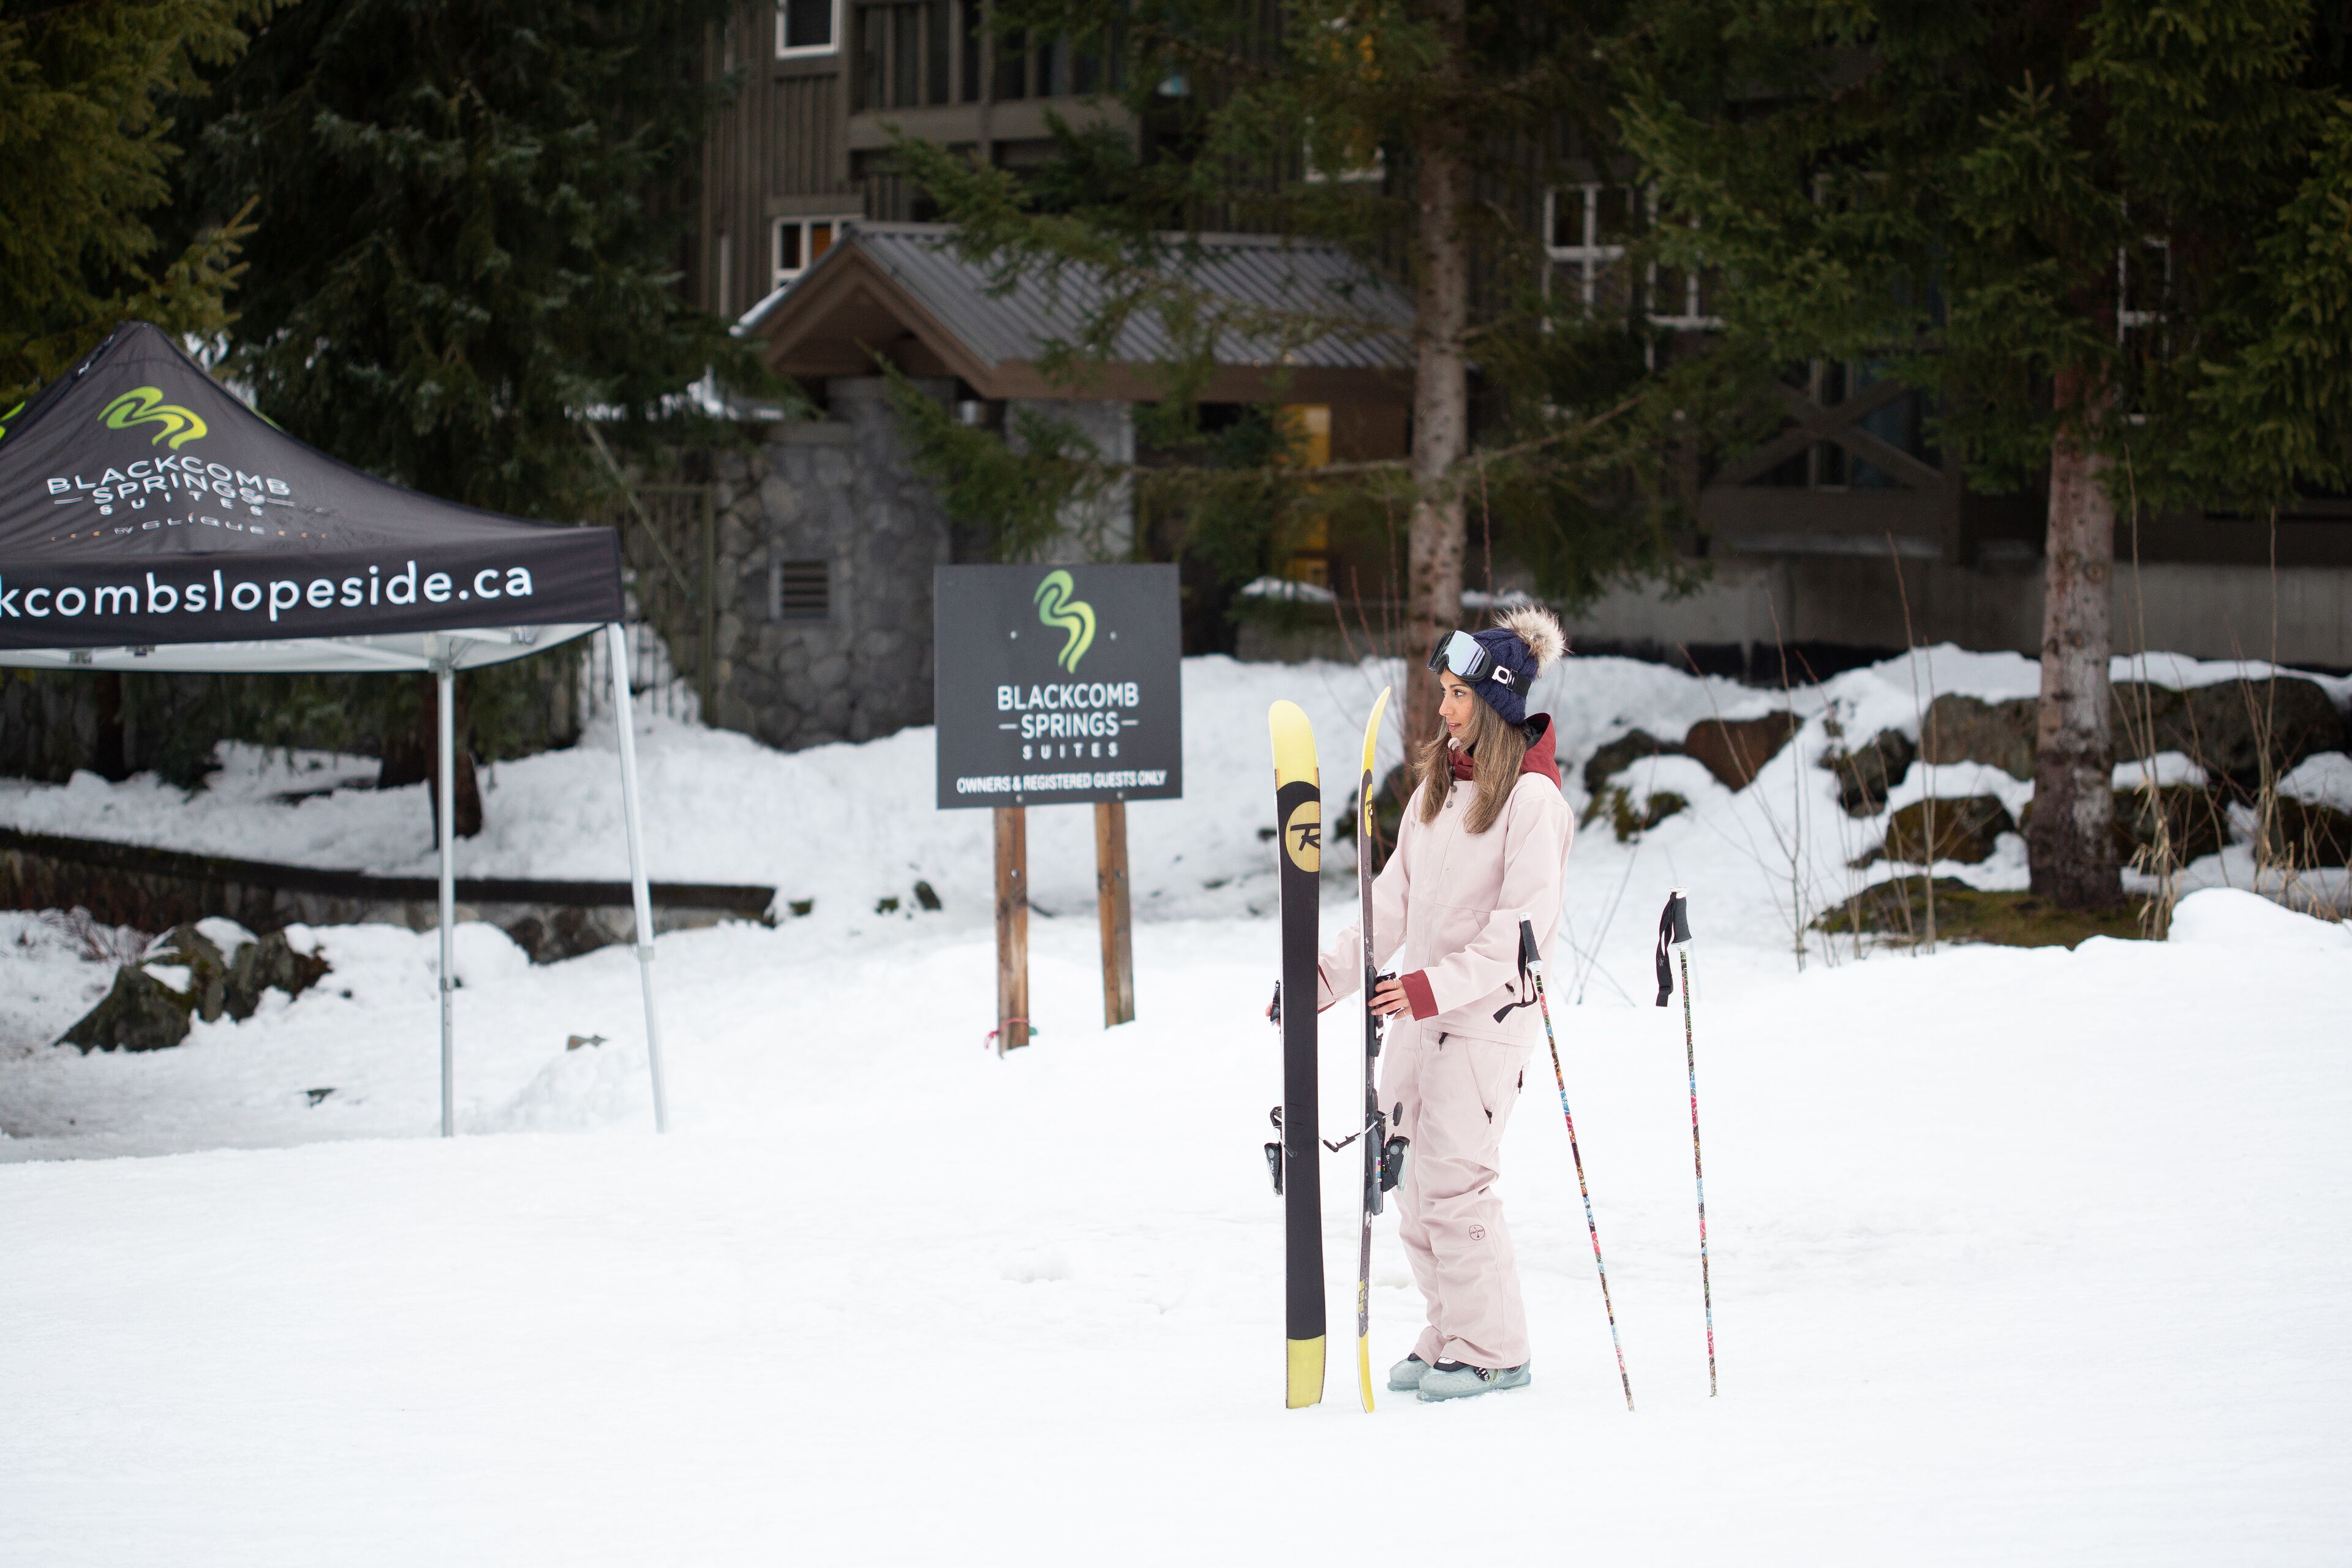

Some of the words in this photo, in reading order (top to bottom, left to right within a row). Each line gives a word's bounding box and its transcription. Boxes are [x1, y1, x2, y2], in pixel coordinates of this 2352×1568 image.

[47, 454, 291, 496] BLACKCOMB
[92, 472, 265, 506] SPRINGS
[99, 491, 263, 516] SUITES
[998, 682, 1140, 710] BLACKCOMB
[1021, 711, 1120, 739] SPRINGS
[1022, 742, 1118, 760] SUITES
[957, 776, 1011, 793] OWNERS
[1012, 775, 1022, 791] &
[1023, 772, 1093, 791] REGISTERED
[1093, 771, 1137, 788] GUESTS
[1137, 769, 1167, 786] ONLY
